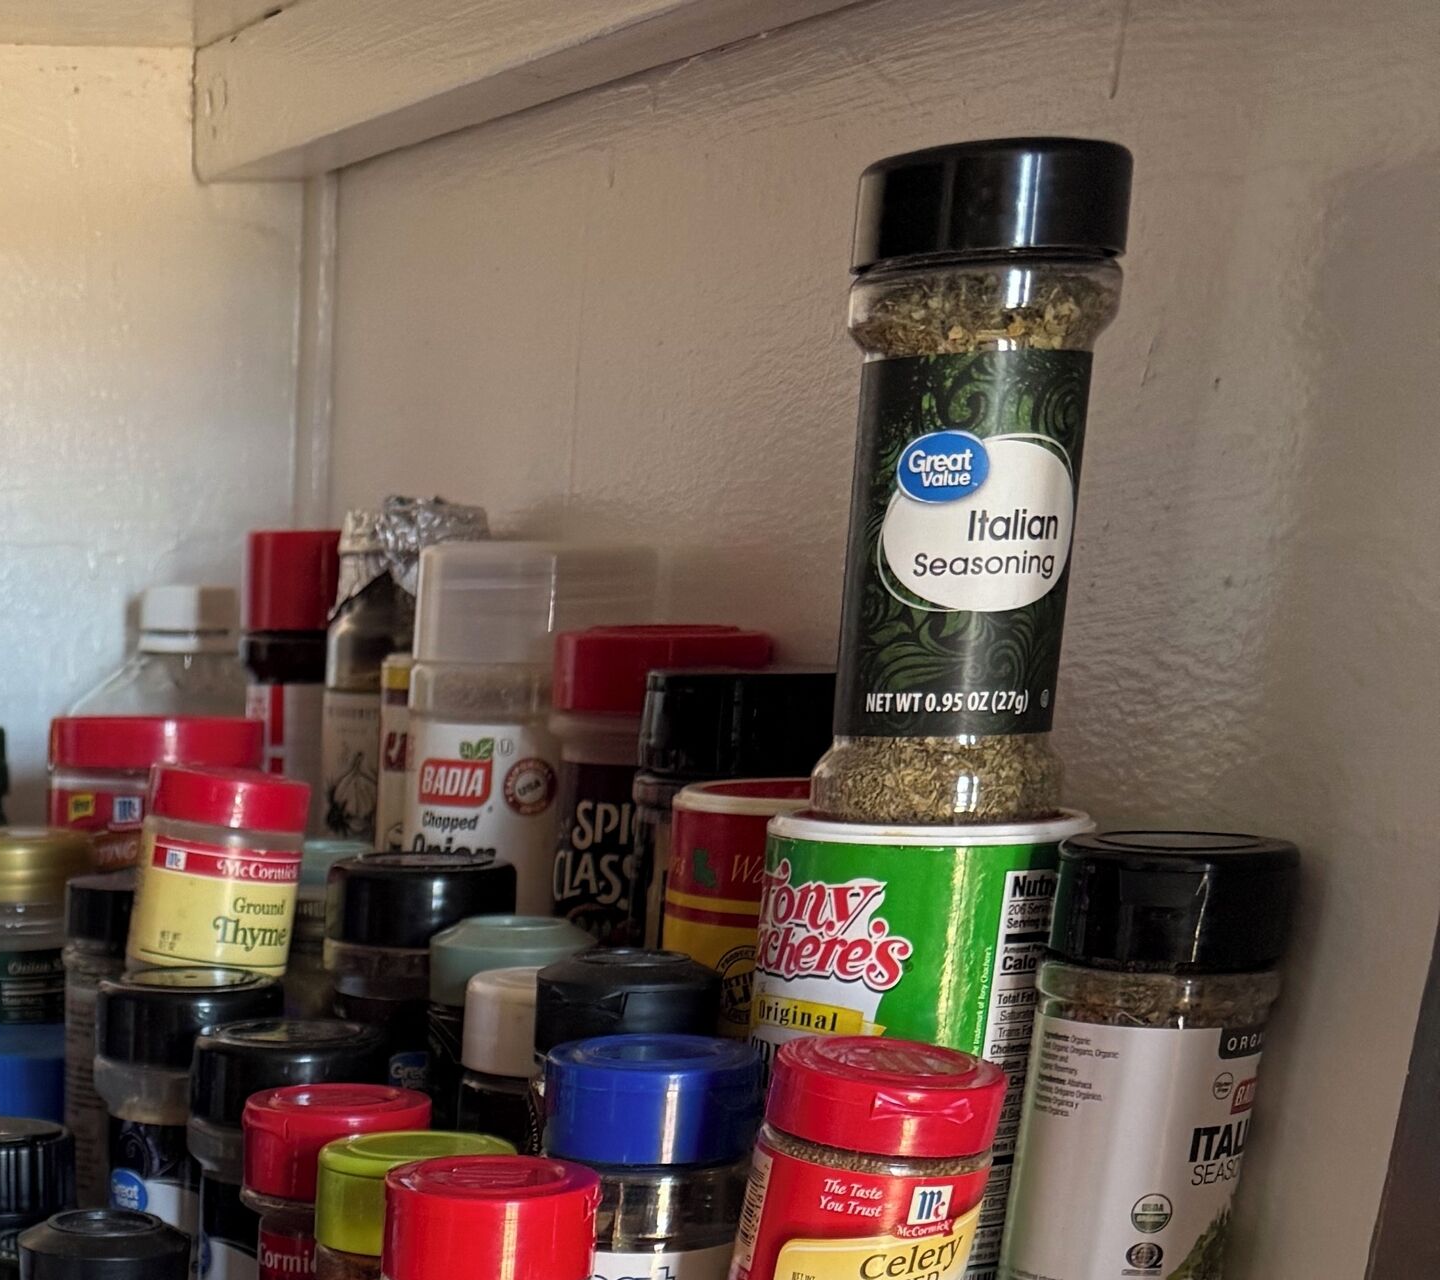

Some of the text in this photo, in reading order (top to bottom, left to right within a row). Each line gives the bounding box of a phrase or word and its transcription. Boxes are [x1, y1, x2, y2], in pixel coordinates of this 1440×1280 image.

[908, 449, 973, 475] Great
[921, 469, 971, 488] Value
[967, 508, 1058, 542] Italian
[912, 551, 1055, 579] Seasoning
[866, 689, 1030, 714] NET WT 0.95 OZ (27g)
[421, 766, 485, 798] BADIA
[422, 810, 480, 833] Chopped
[233, 897, 285, 916] Ground
[213, 916, 287, 952] Thyme
[824, 1178, 883, 1200] The Taste
[819, 1195, 883, 1218] You Trust
[896, 1219, 952, 1237] McCormick
[859, 1235, 963, 1280] Celery
